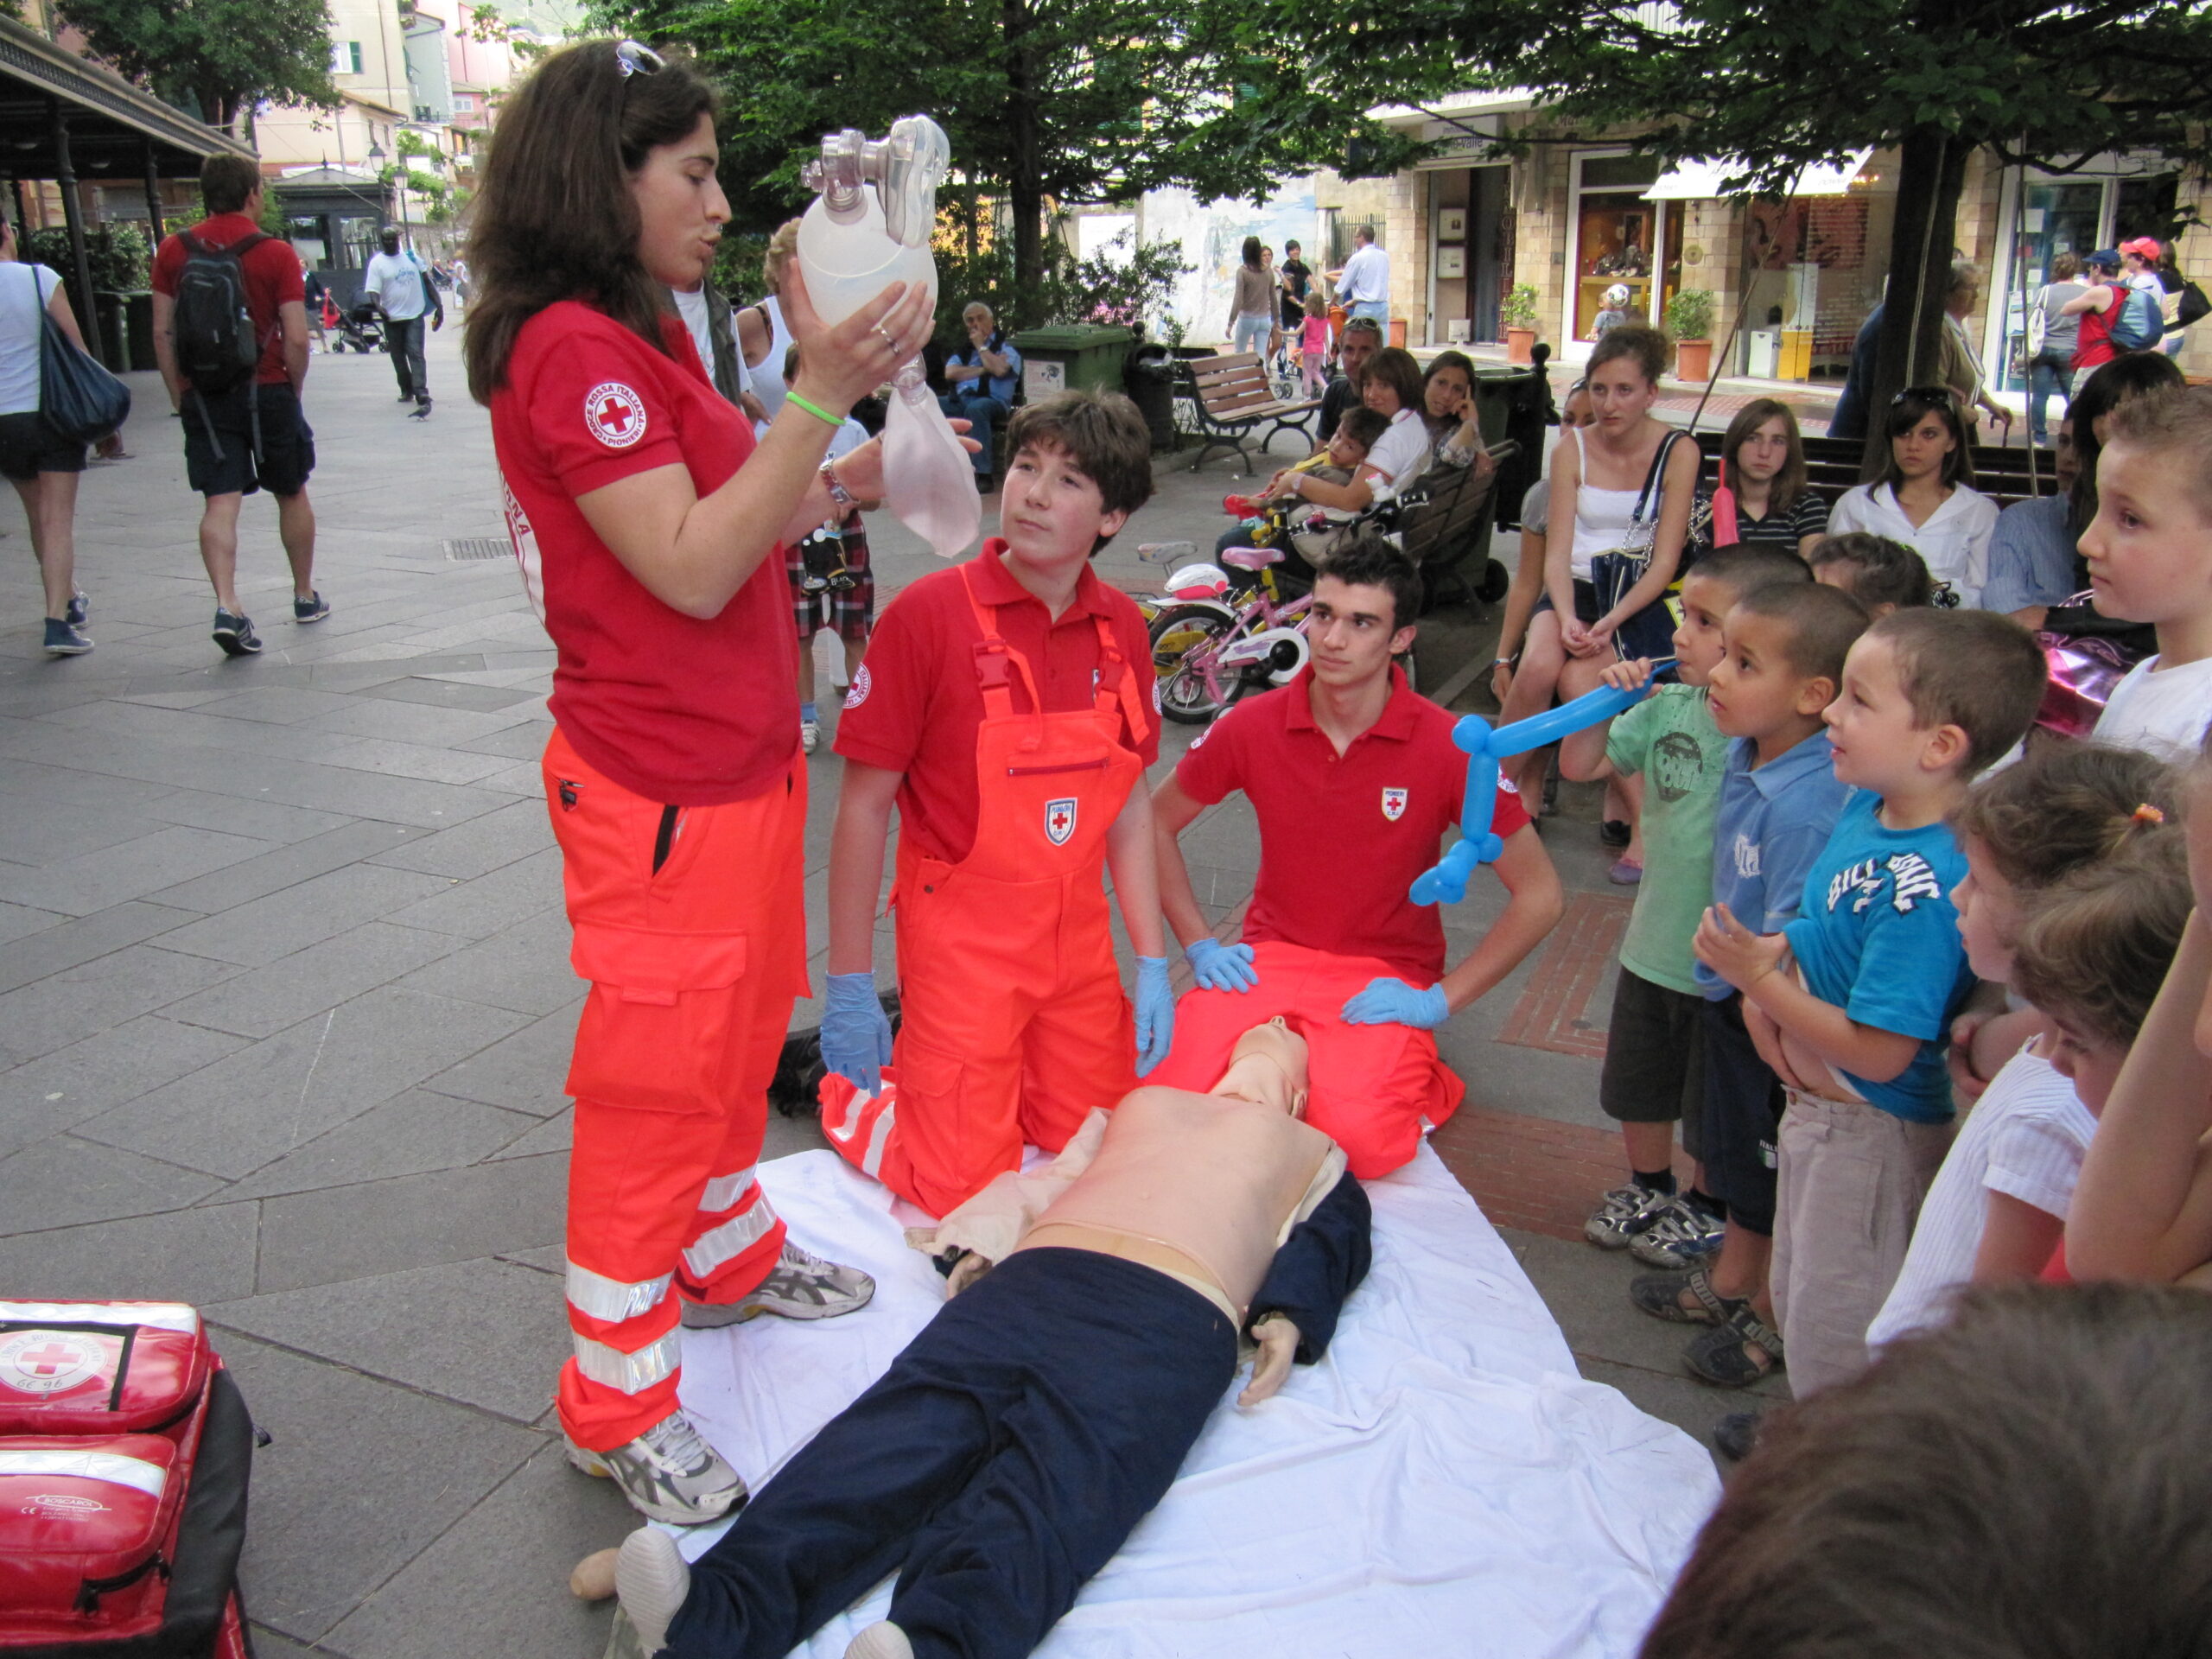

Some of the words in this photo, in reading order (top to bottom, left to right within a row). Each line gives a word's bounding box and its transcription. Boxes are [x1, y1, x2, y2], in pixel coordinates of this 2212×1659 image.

[588, 385, 614, 406] ROSSA
[617, 385, 645, 423] ITALIANA
[587, 409, 603, 439] CROCE
[607, 429, 642, 446] PIONIERI
[21, 1506, 37, 1515] CE
[44, 1497, 94, 1507] BOSCAROL
